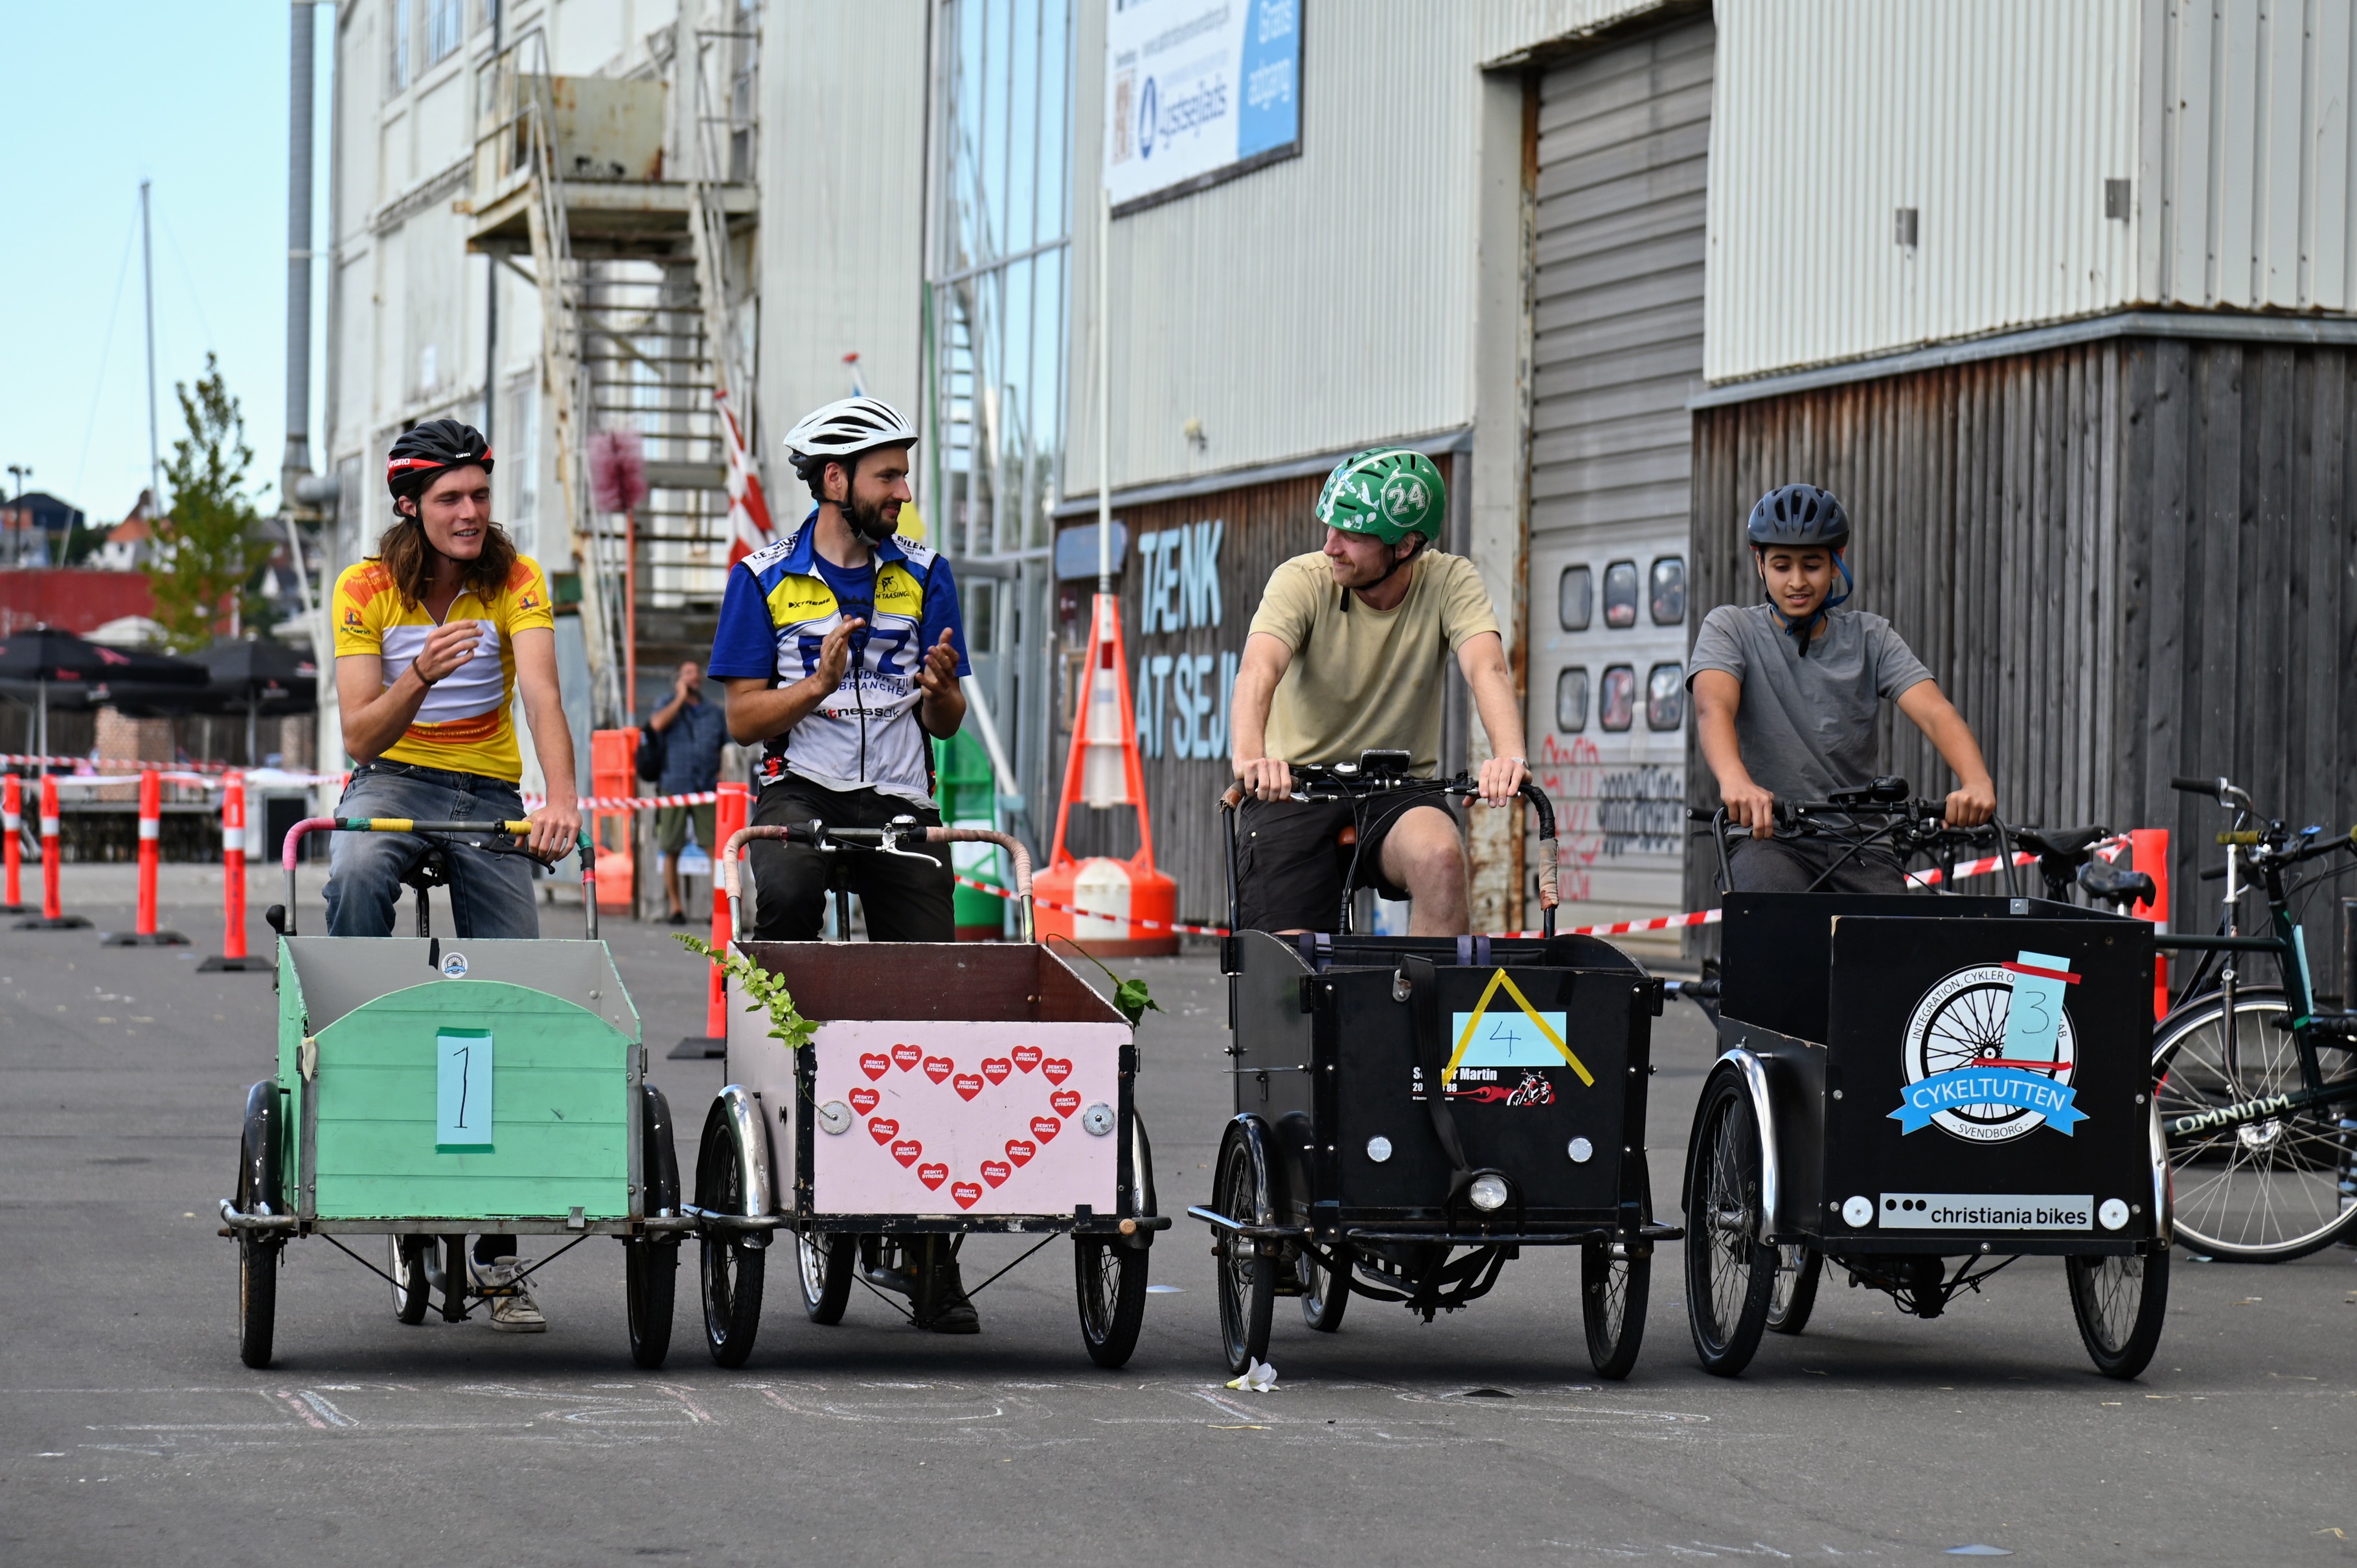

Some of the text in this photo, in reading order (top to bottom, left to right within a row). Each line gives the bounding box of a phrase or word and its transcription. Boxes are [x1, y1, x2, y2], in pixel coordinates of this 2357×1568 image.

[394, 458, 411, 467] GIRO
[1387, 482, 1426, 516] 24
[1138, 519, 1224, 635] TÆNK
[1135, 654, 1173, 760] AT
[1912, 978, 1963, 1040] INTEGRATION,
[1964, 970, 2004, 984] CYKLER
[2021, 991, 2049, 1034] 3
[1490, 1021, 1521, 1058] 4
[453, 1046, 469, 1129] 1
[1459, 1067, 1497, 1081] Martin
[1913, 1078, 2066, 1112] CYKELTUTTEN
[1957, 1122, 2023, 1139] SVENDBORG
[2175, 1093, 2296, 1137] OMNIUM
[1931, 1207, 2087, 1225] christiania bikes
